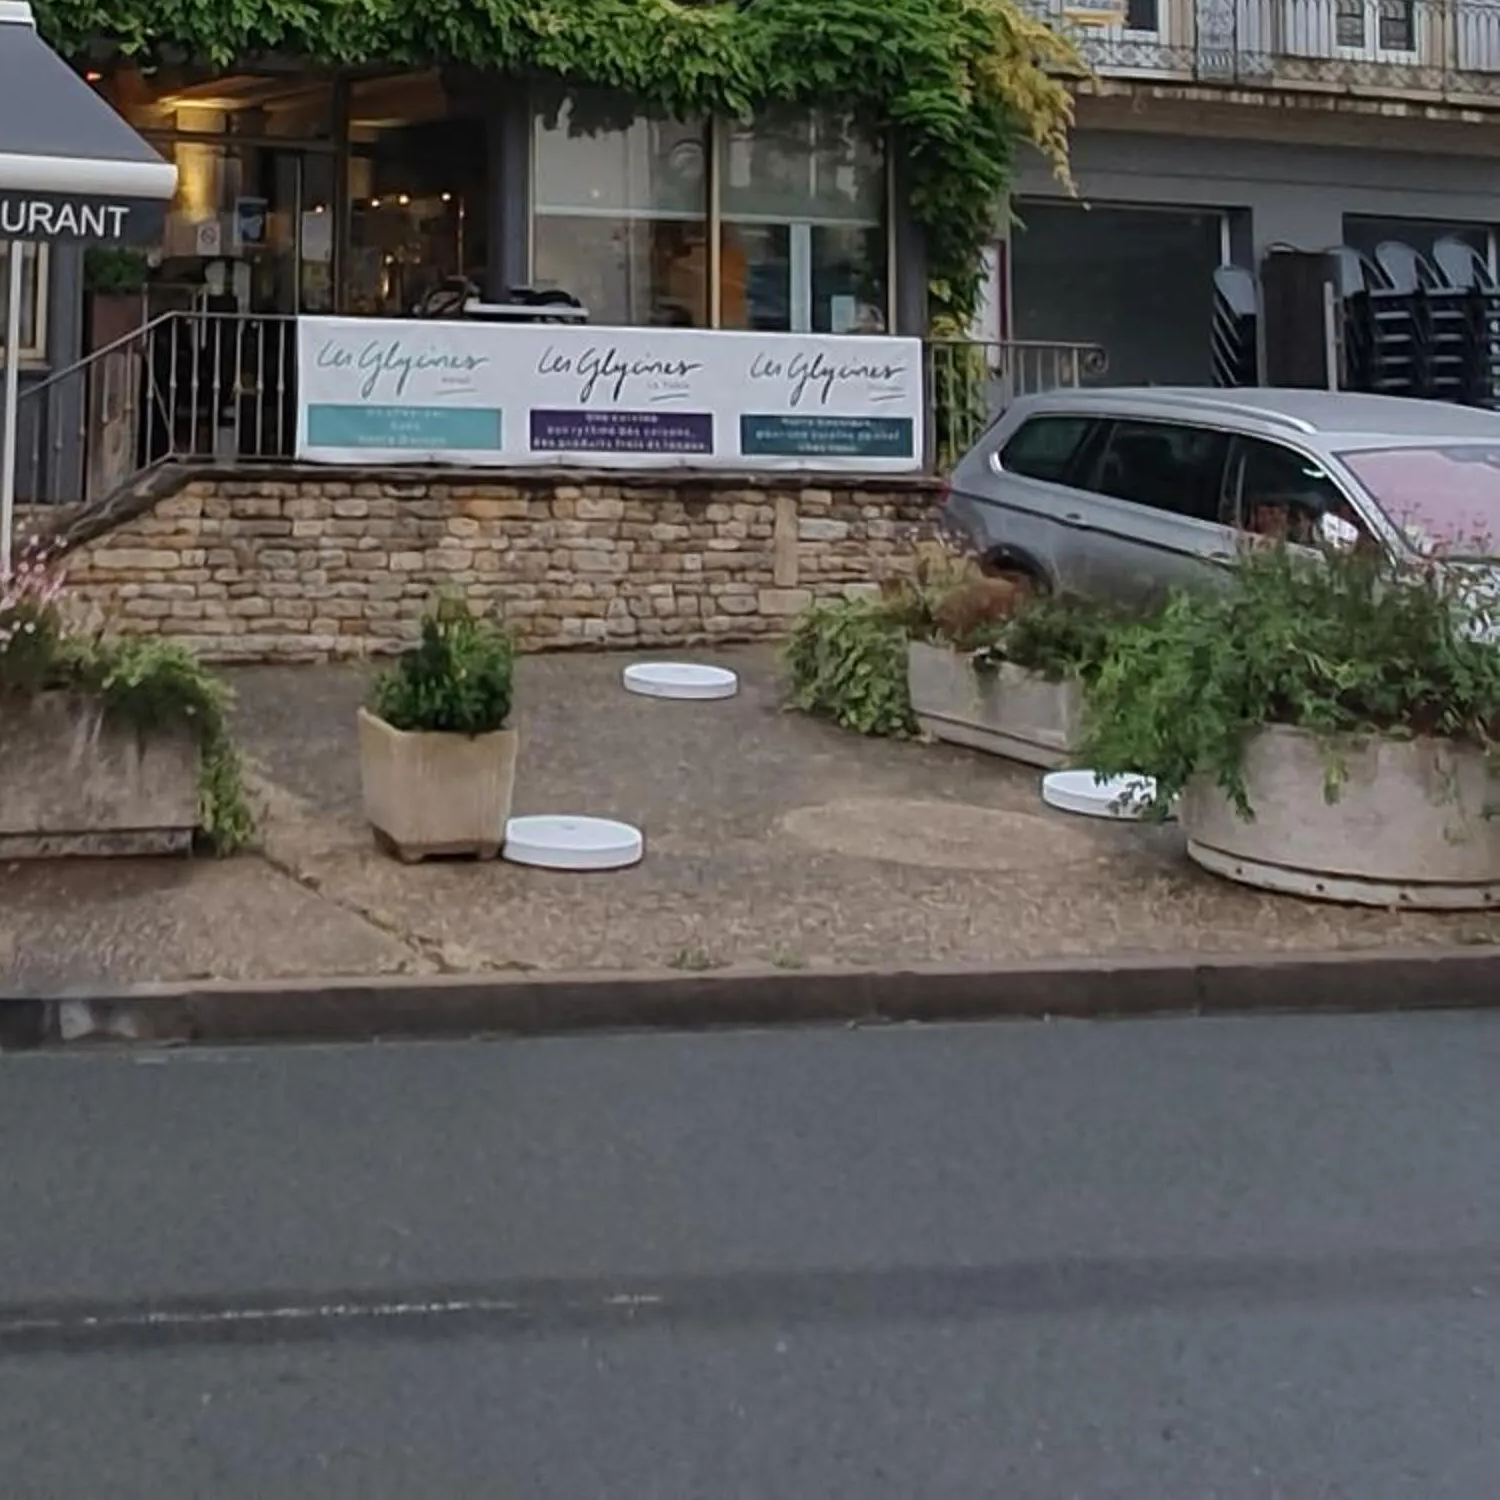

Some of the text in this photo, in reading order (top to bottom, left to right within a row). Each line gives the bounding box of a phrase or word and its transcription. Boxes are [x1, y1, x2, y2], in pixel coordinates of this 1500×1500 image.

[316, 338, 490, 399] Les Glycines
[537, 345, 704, 403] Les Glycines
[749, 352, 908, 407] Les Glycines
